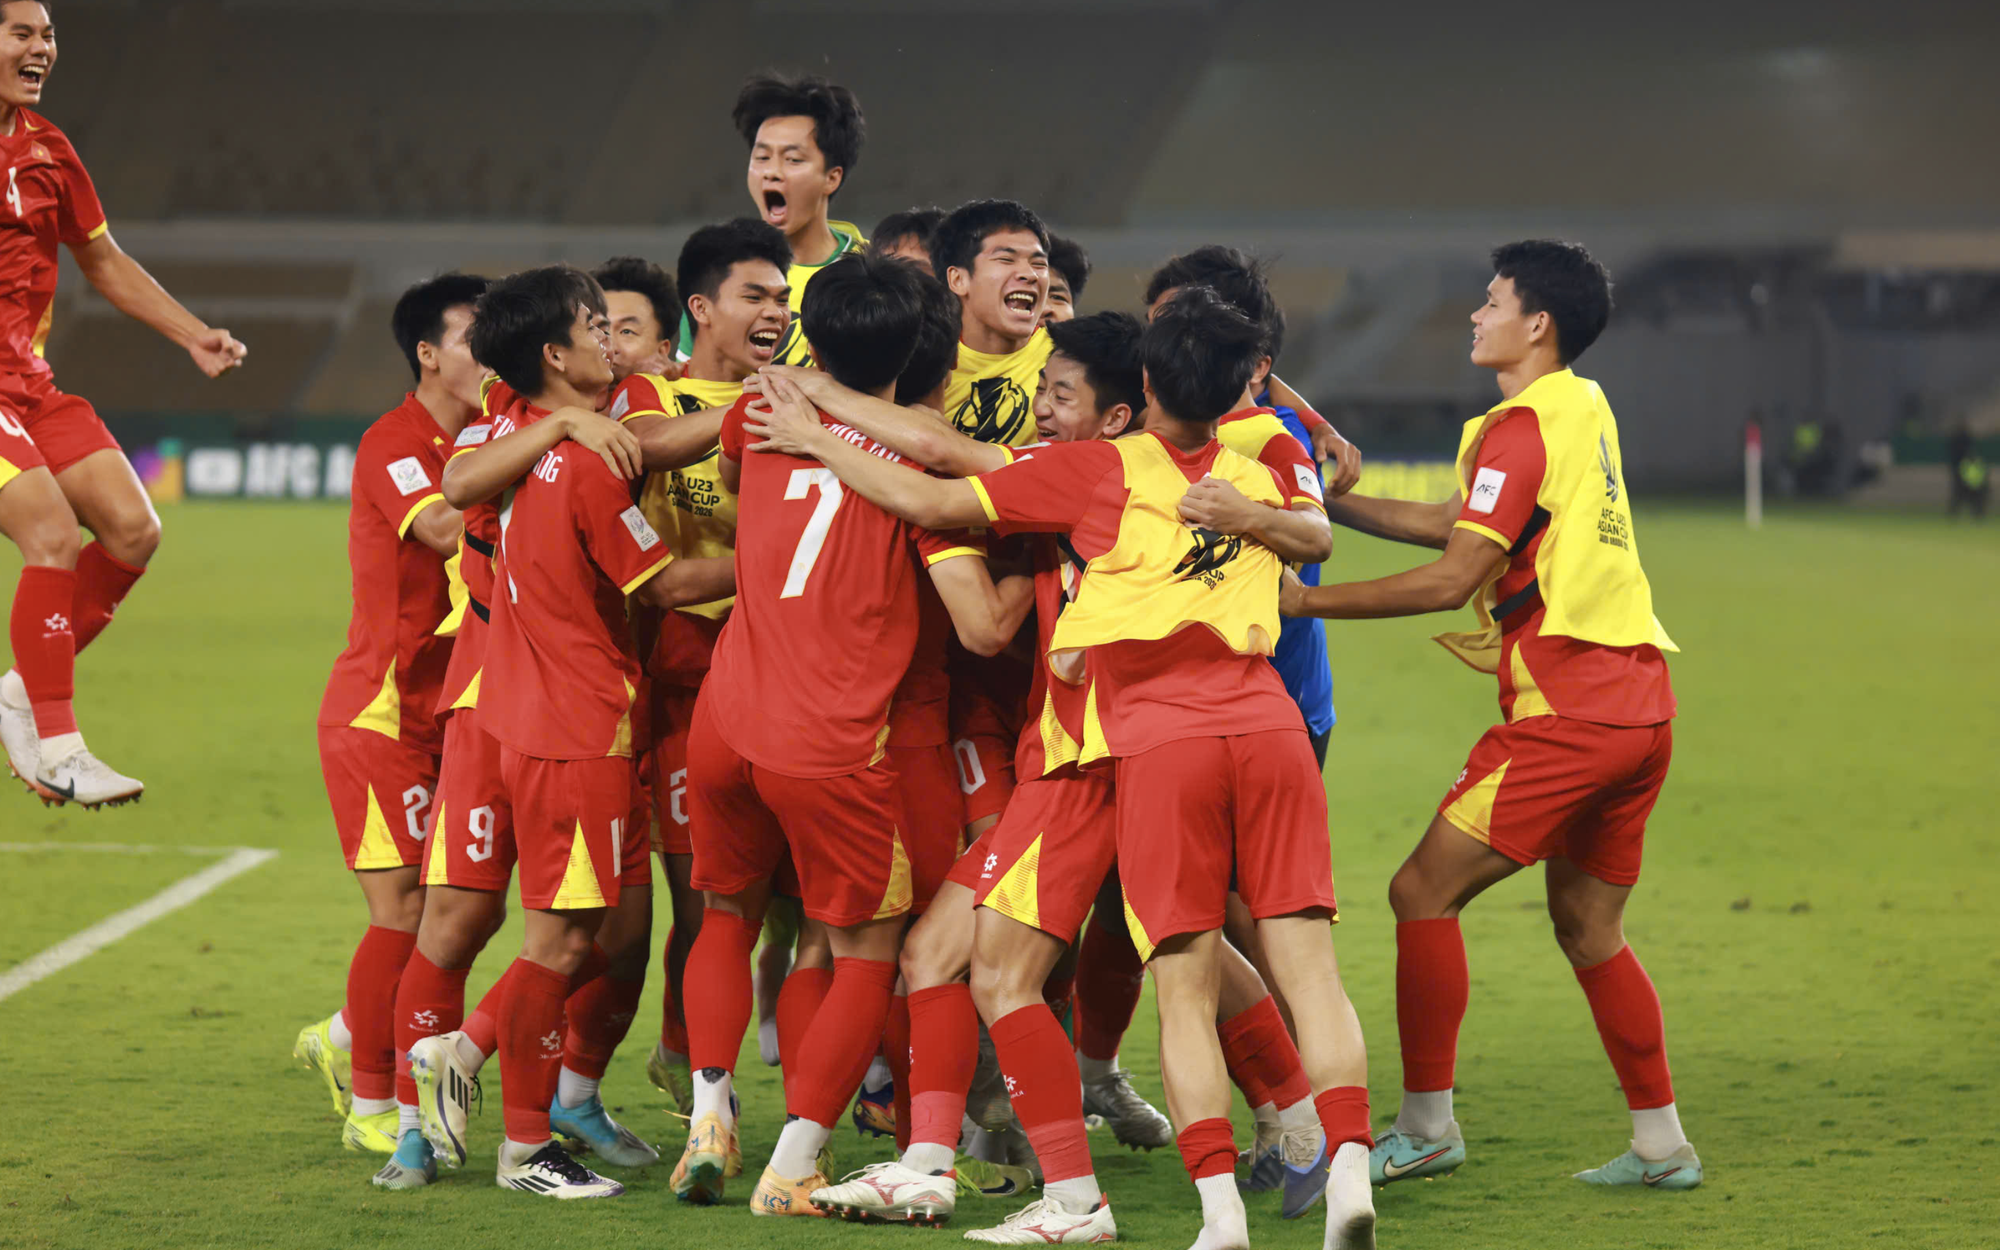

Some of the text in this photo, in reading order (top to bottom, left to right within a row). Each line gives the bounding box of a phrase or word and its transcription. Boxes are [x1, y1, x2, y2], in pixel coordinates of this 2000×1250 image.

[6, 166, 23, 218] 4
[687, 476, 713, 493] U23
[1476, 483, 1497, 496] AFC
[690, 491, 720, 507] CUP
[694, 505, 713, 517] 2026
[1601, 506, 1615, 522] AFC
[779, 467, 844, 599] 7
[1597, 518, 1619, 537] ASIAN
[402, 783, 431, 842] 2
[466, 804, 496, 863] 9
